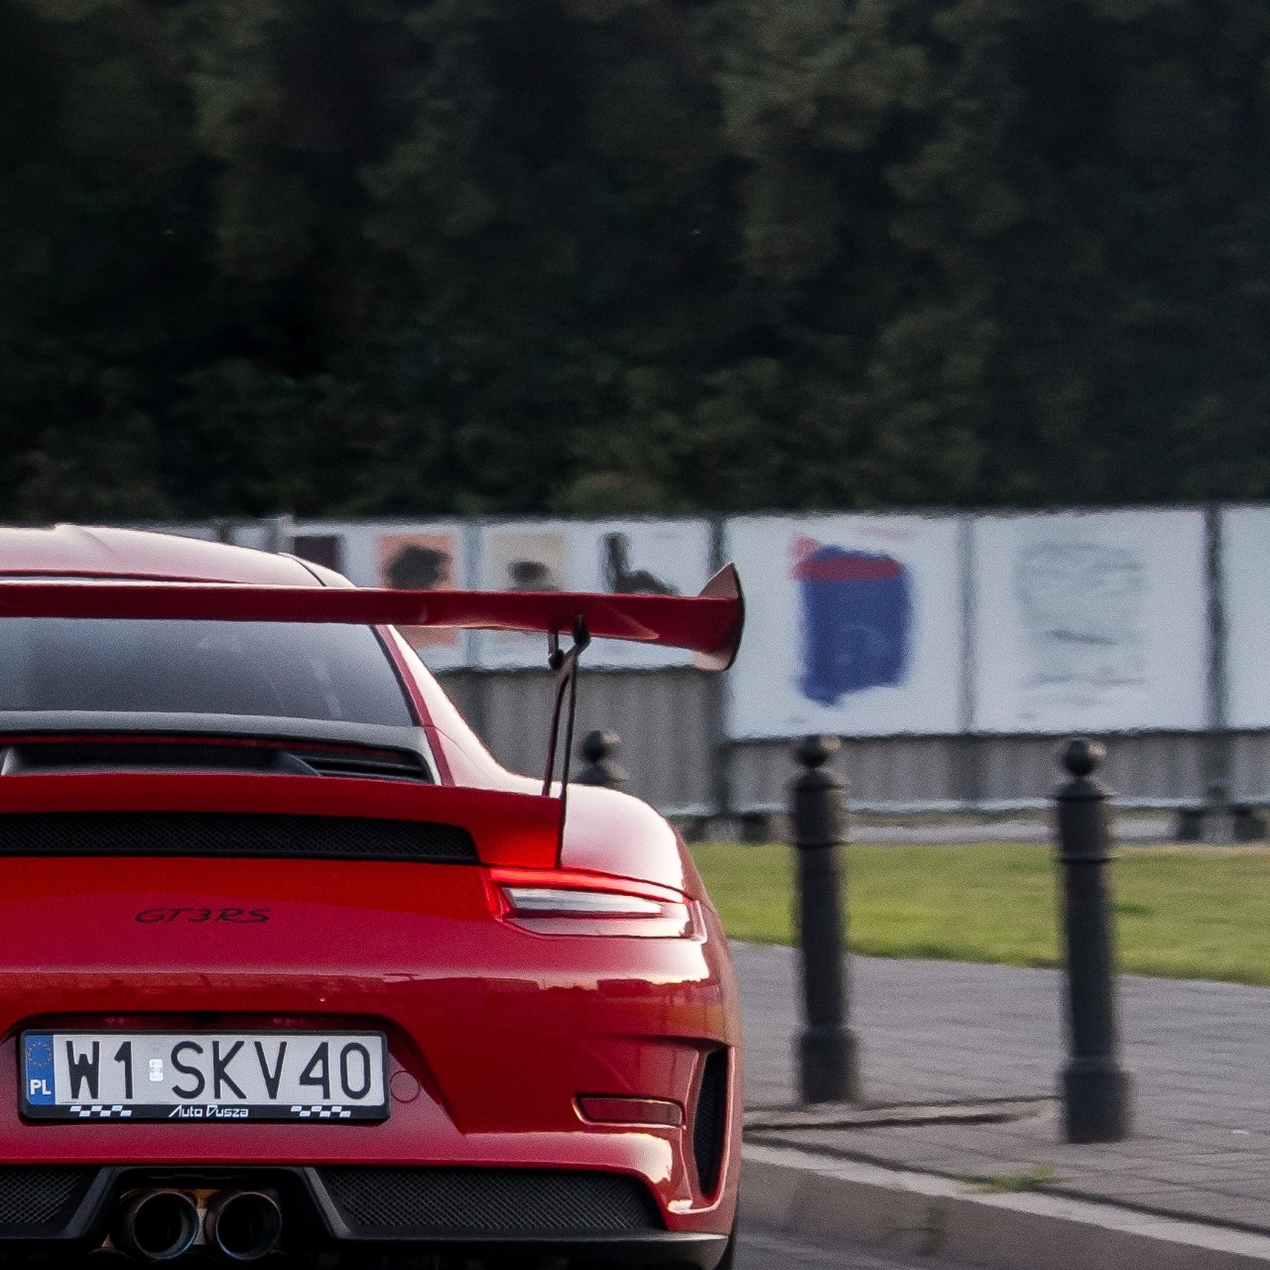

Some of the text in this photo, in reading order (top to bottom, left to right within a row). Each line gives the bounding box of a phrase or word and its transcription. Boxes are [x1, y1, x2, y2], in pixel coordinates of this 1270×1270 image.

[66, 1040, 371, 1100] W1 SKV40
[30, 1079, 52, 1096] PL
[169, 1105, 249, 1118] Auto Dusza
